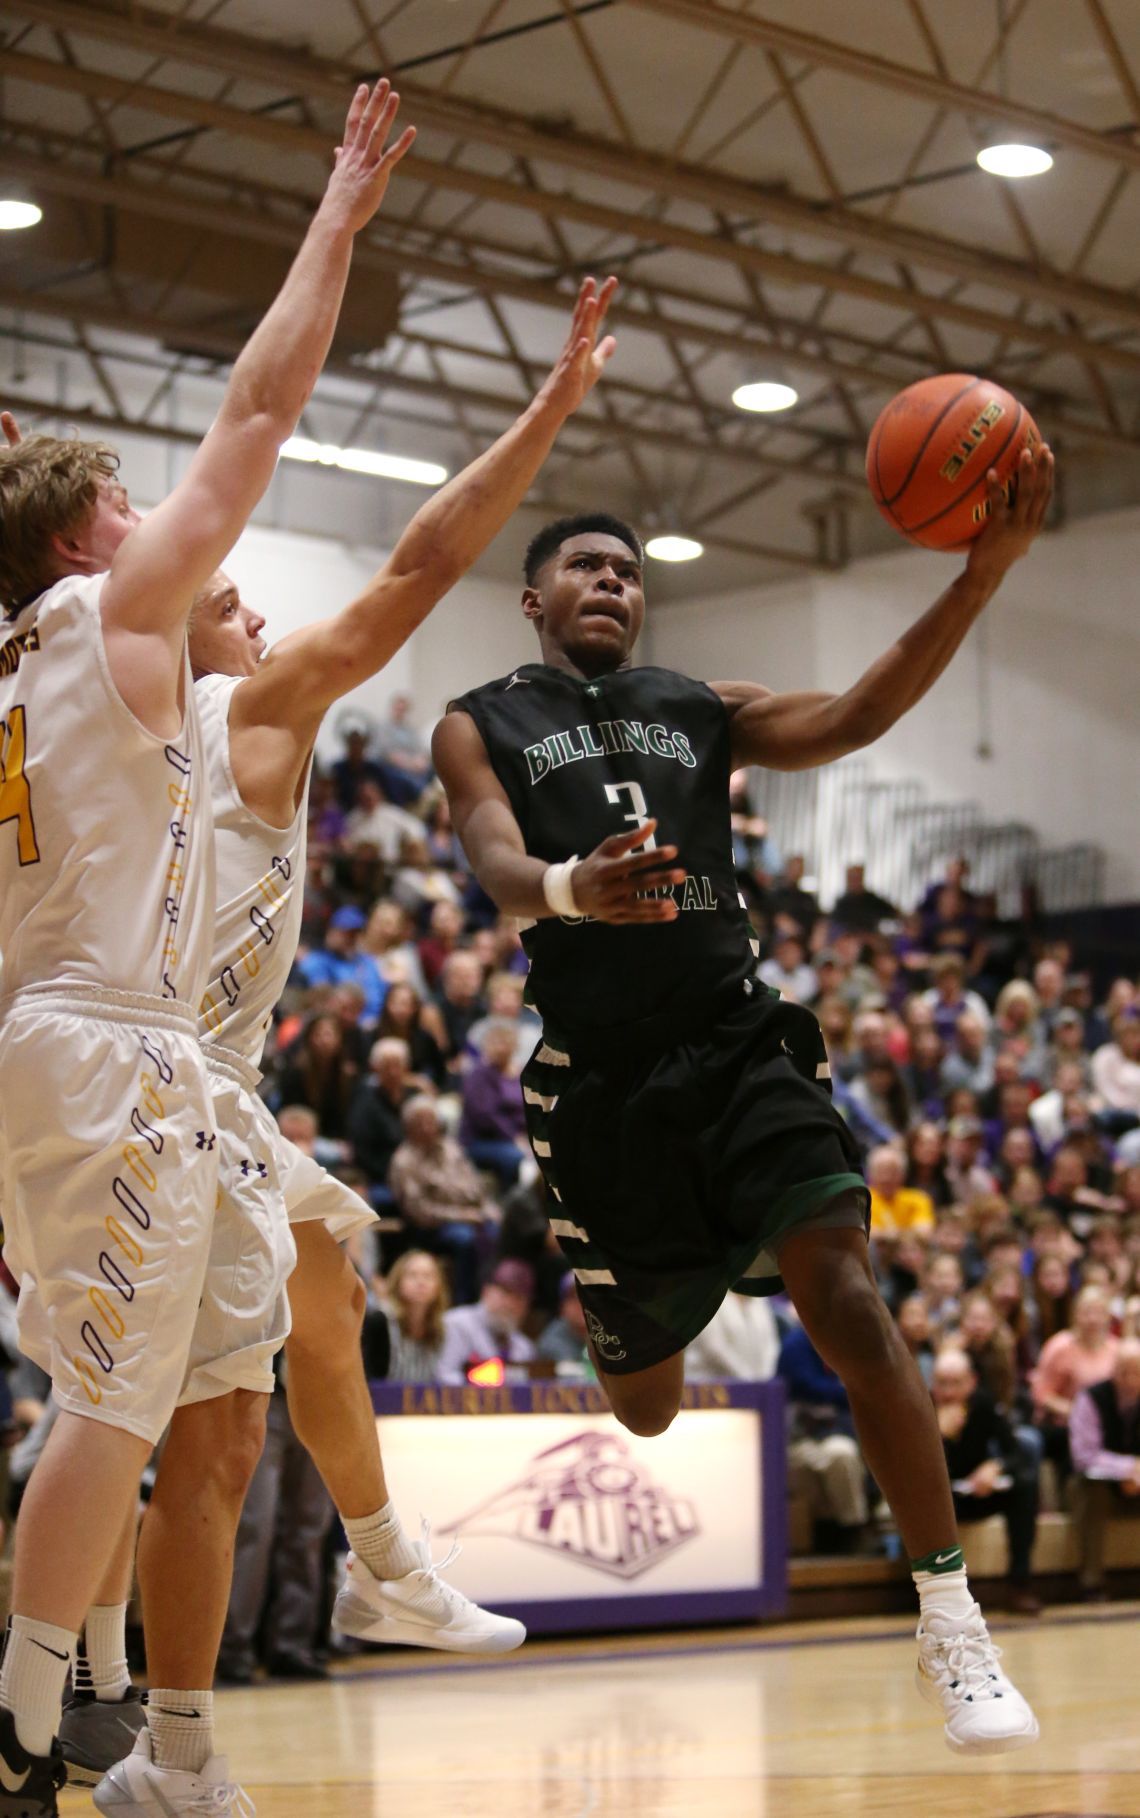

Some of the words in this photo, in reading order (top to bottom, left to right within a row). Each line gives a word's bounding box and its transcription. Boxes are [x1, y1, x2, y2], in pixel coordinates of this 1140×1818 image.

[939, 400, 1005, 483] ELITE
[524, 720, 697, 785] BILLINGS
[604, 781, 657, 859] 3
